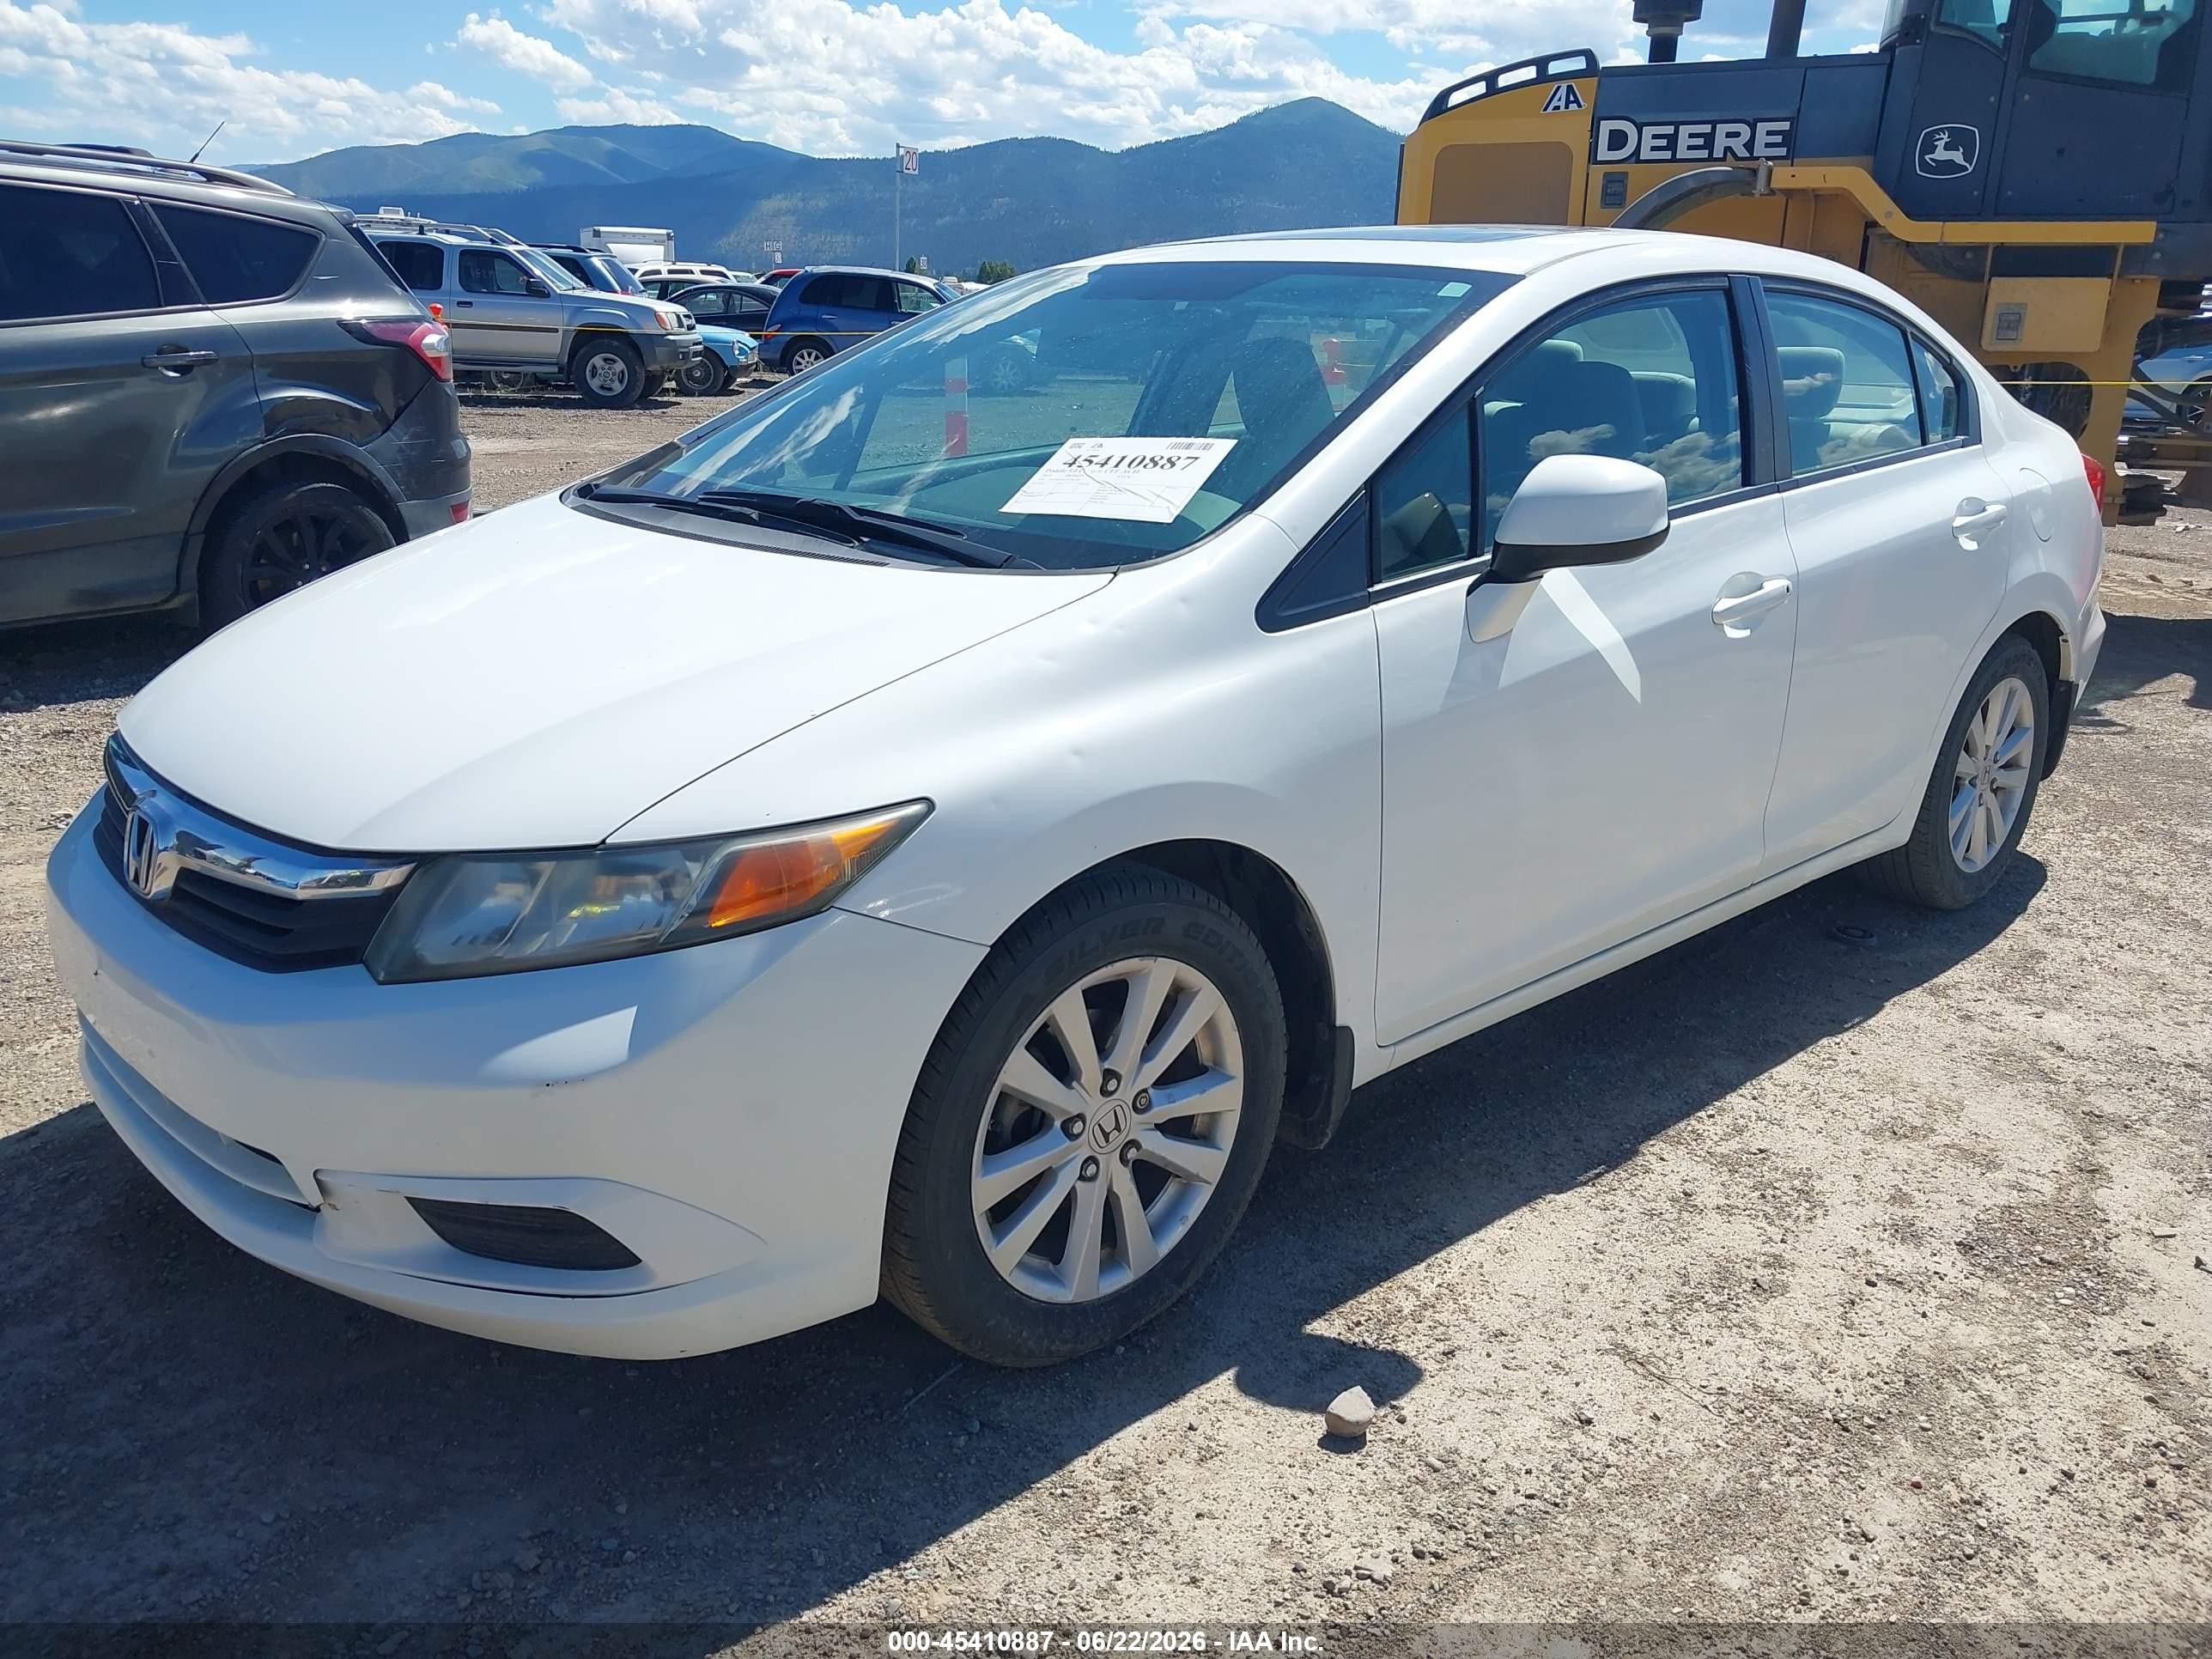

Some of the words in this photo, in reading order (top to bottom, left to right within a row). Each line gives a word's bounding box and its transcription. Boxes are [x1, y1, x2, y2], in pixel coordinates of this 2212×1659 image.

[1596, 119, 1790, 161] DEERE
[904, 150, 917, 172] 20
[1062, 454, 1201, 471] 45410887
[1043, 916, 1166, 983] SILVER
